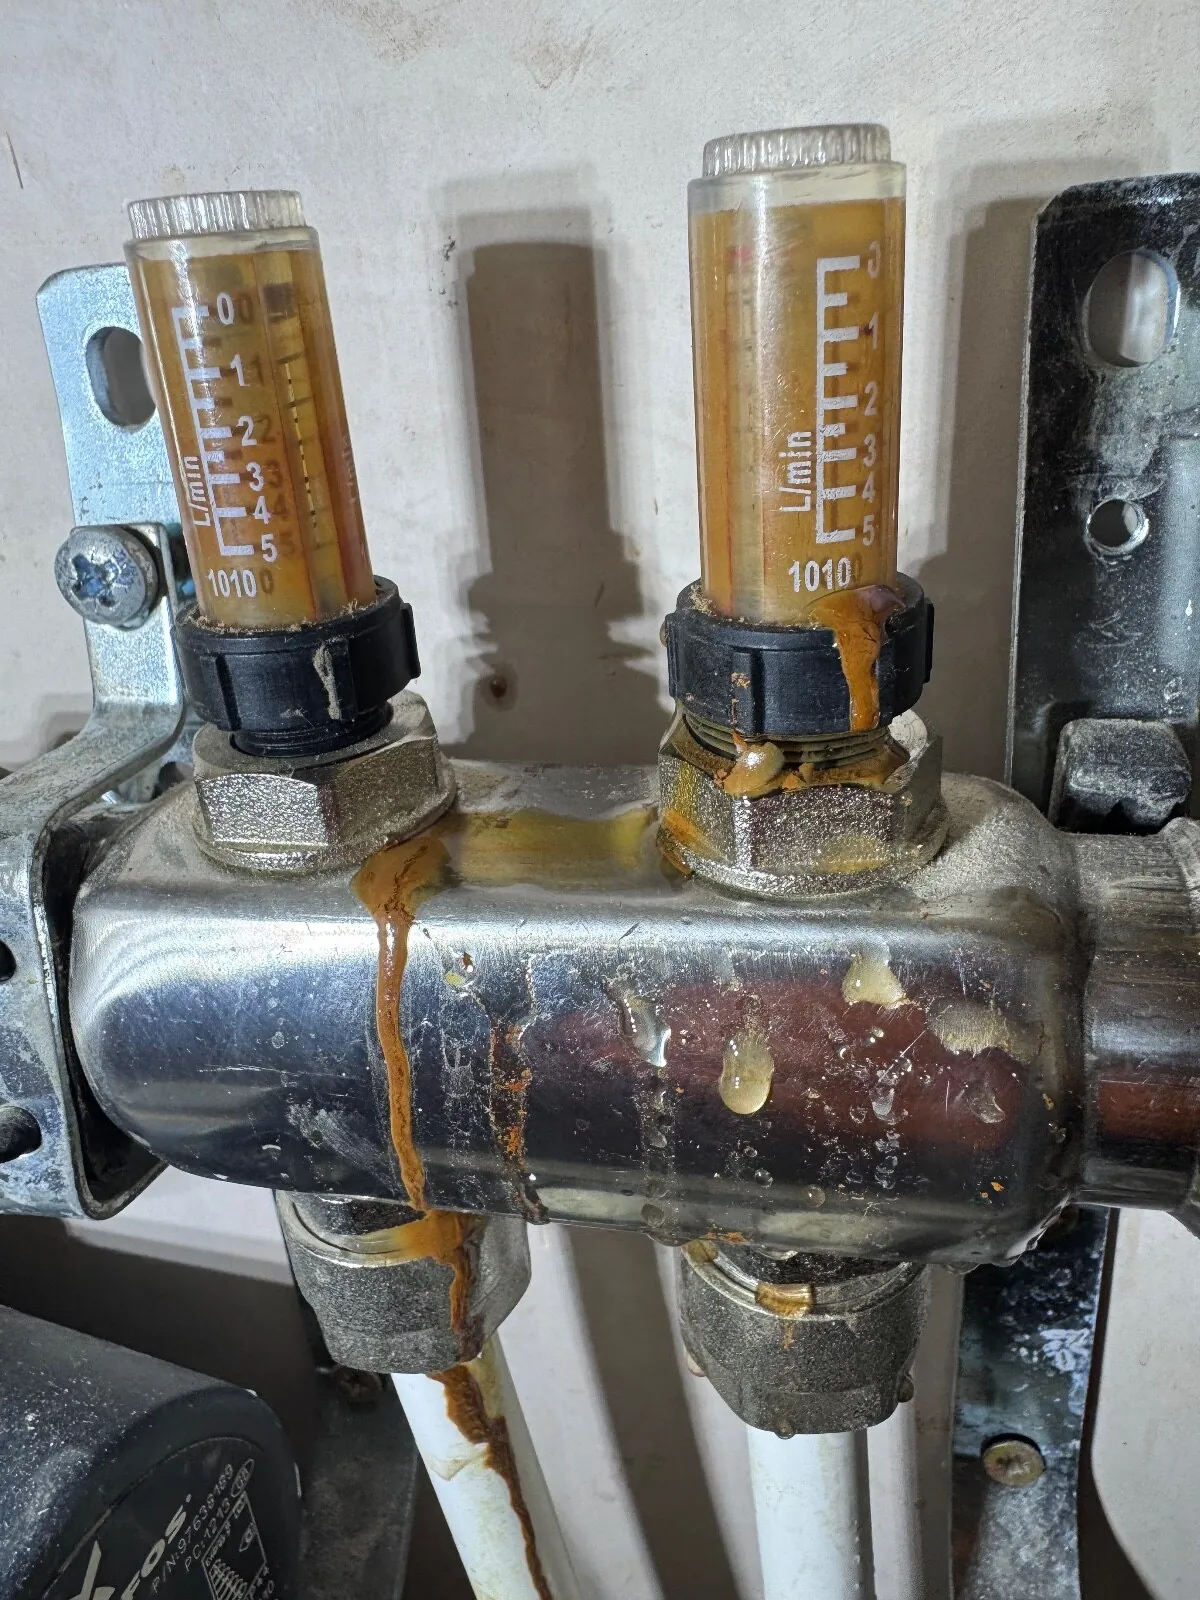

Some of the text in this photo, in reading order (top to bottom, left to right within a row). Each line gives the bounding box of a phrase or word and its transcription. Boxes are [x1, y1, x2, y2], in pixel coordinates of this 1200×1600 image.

[216, 292, 235, 325] 0
[867, 312, 879, 350] 1
[230, 354, 250, 386] 1
[864, 381, 878, 417] 2
[236, 415, 257, 446] 2
[863, 433, 877, 467] 3
[246, 462, 265, 492] 3
[778, 431, 812, 512] L/min
[861, 470, 876, 504] 4
[183, 455, 211, 527] L/min
[253, 496, 273, 524] 4
[862, 514, 876, 547] 5
[261, 533, 278, 563] 5
